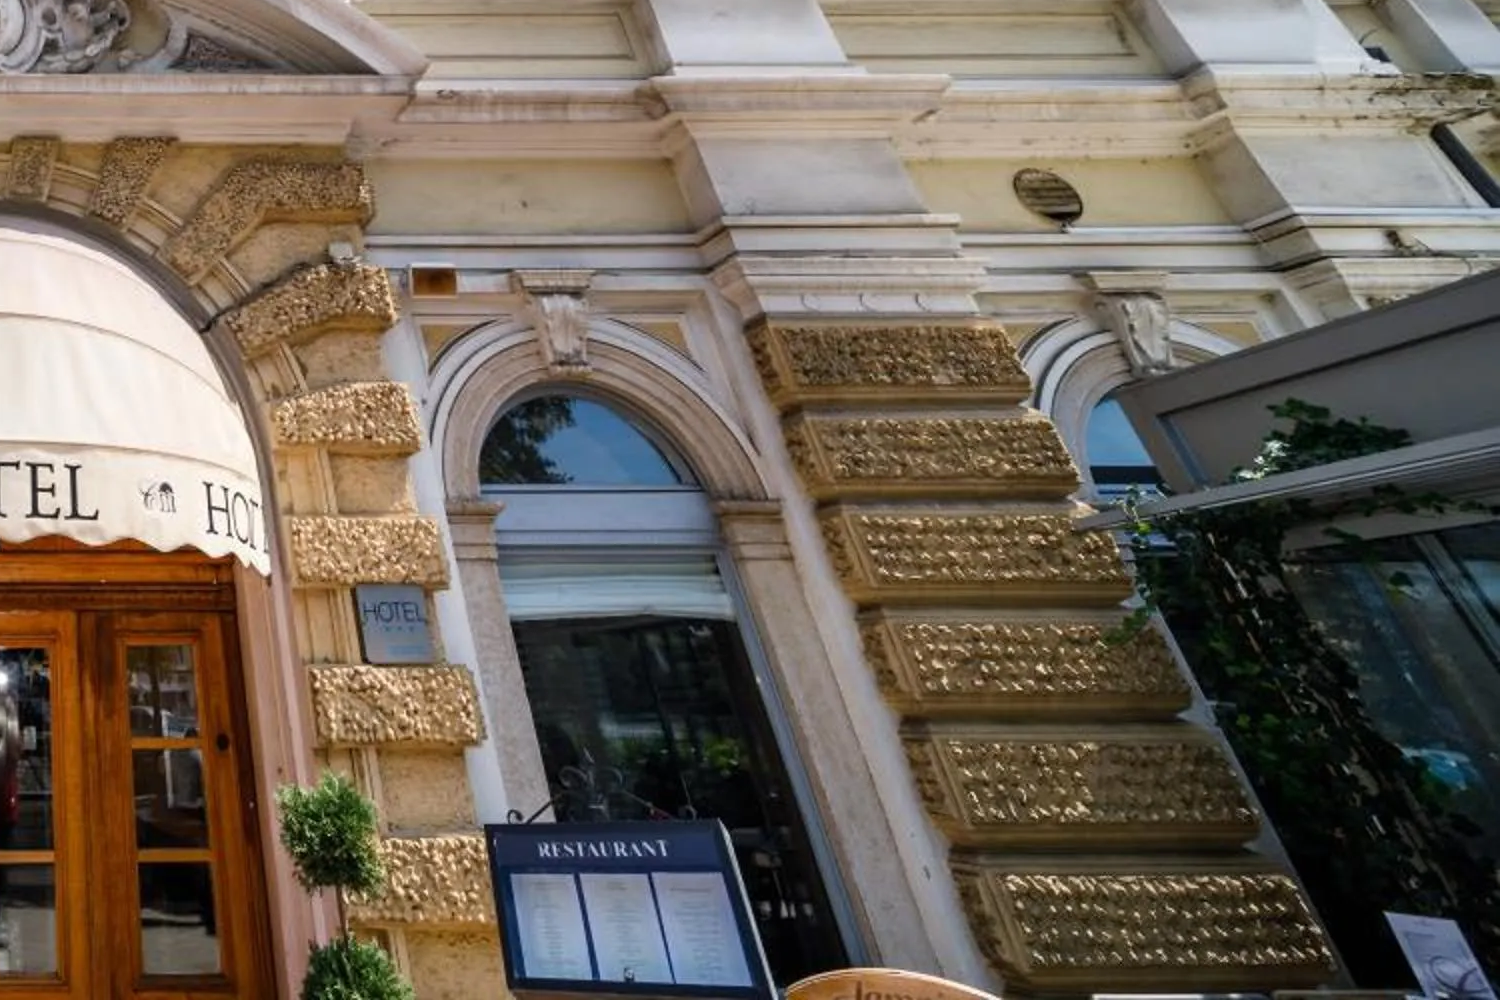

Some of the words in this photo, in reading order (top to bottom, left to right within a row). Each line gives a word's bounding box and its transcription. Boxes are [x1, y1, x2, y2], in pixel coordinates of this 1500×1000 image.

[202, 481, 267, 553] HOT
[363, 601, 428, 624] HOTEL
[537, 839, 669, 857] RESTAURANT
